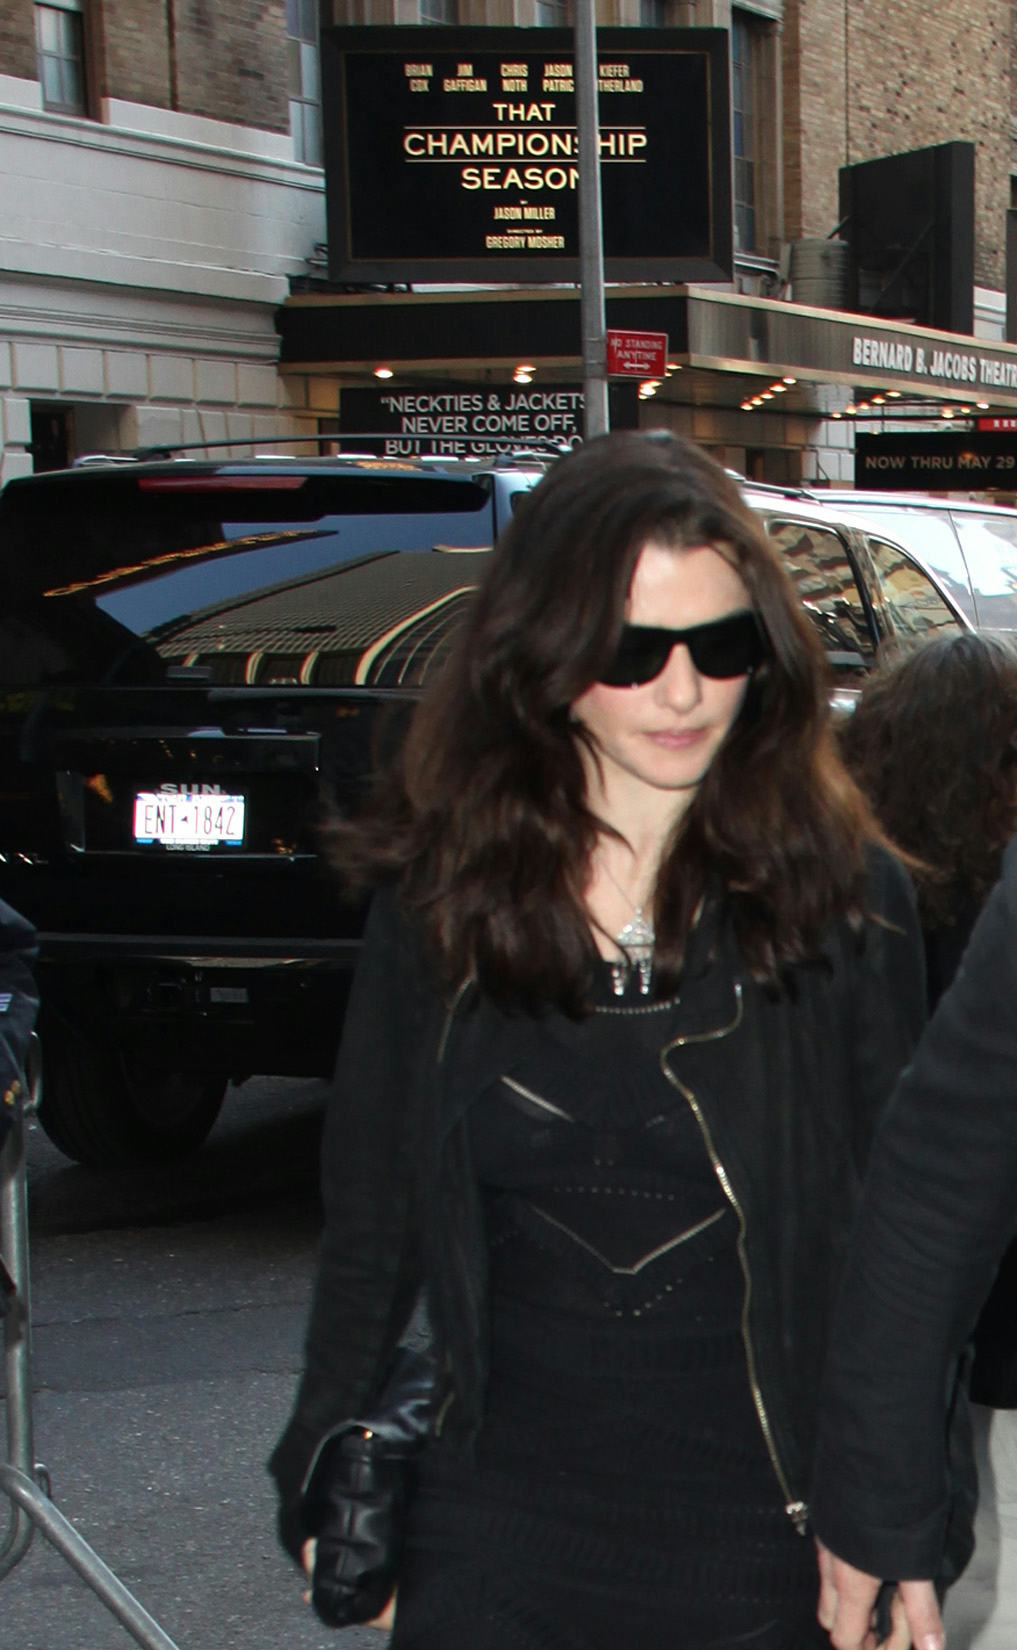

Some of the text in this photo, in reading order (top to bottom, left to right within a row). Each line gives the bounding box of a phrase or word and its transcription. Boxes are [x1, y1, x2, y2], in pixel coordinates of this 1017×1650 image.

[404, 64, 630, 78] BRIAN JIM CHRIS JASON KIEFER
[409, 79, 643, 92] COX GAFFIGAN NOTH PATRIC THERLAND
[493, 103, 556, 121] THAT
[493, 207, 556, 220] JASON MILLER
[485, 236, 565, 249] GREGORY MOSHER
[610, 337, 663, 350] NO STANDING
[617, 350, 657, 360] ANYTIME
[853, 337, 913, 372] BERNARD
[915, 347, 928, 375] B.
[930, 350, 977, 384] JACOBS
[487, 394, 501, 412] &
[402, 413, 577, 434] NEVER COME OFF,
[385, 440, 422, 455] BUT
[865, 455, 906, 470] NOW
[912, 455, 953, 470] THRU
[958, 455, 992, 469] MAY
[996, 455, 1016, 469] 29
